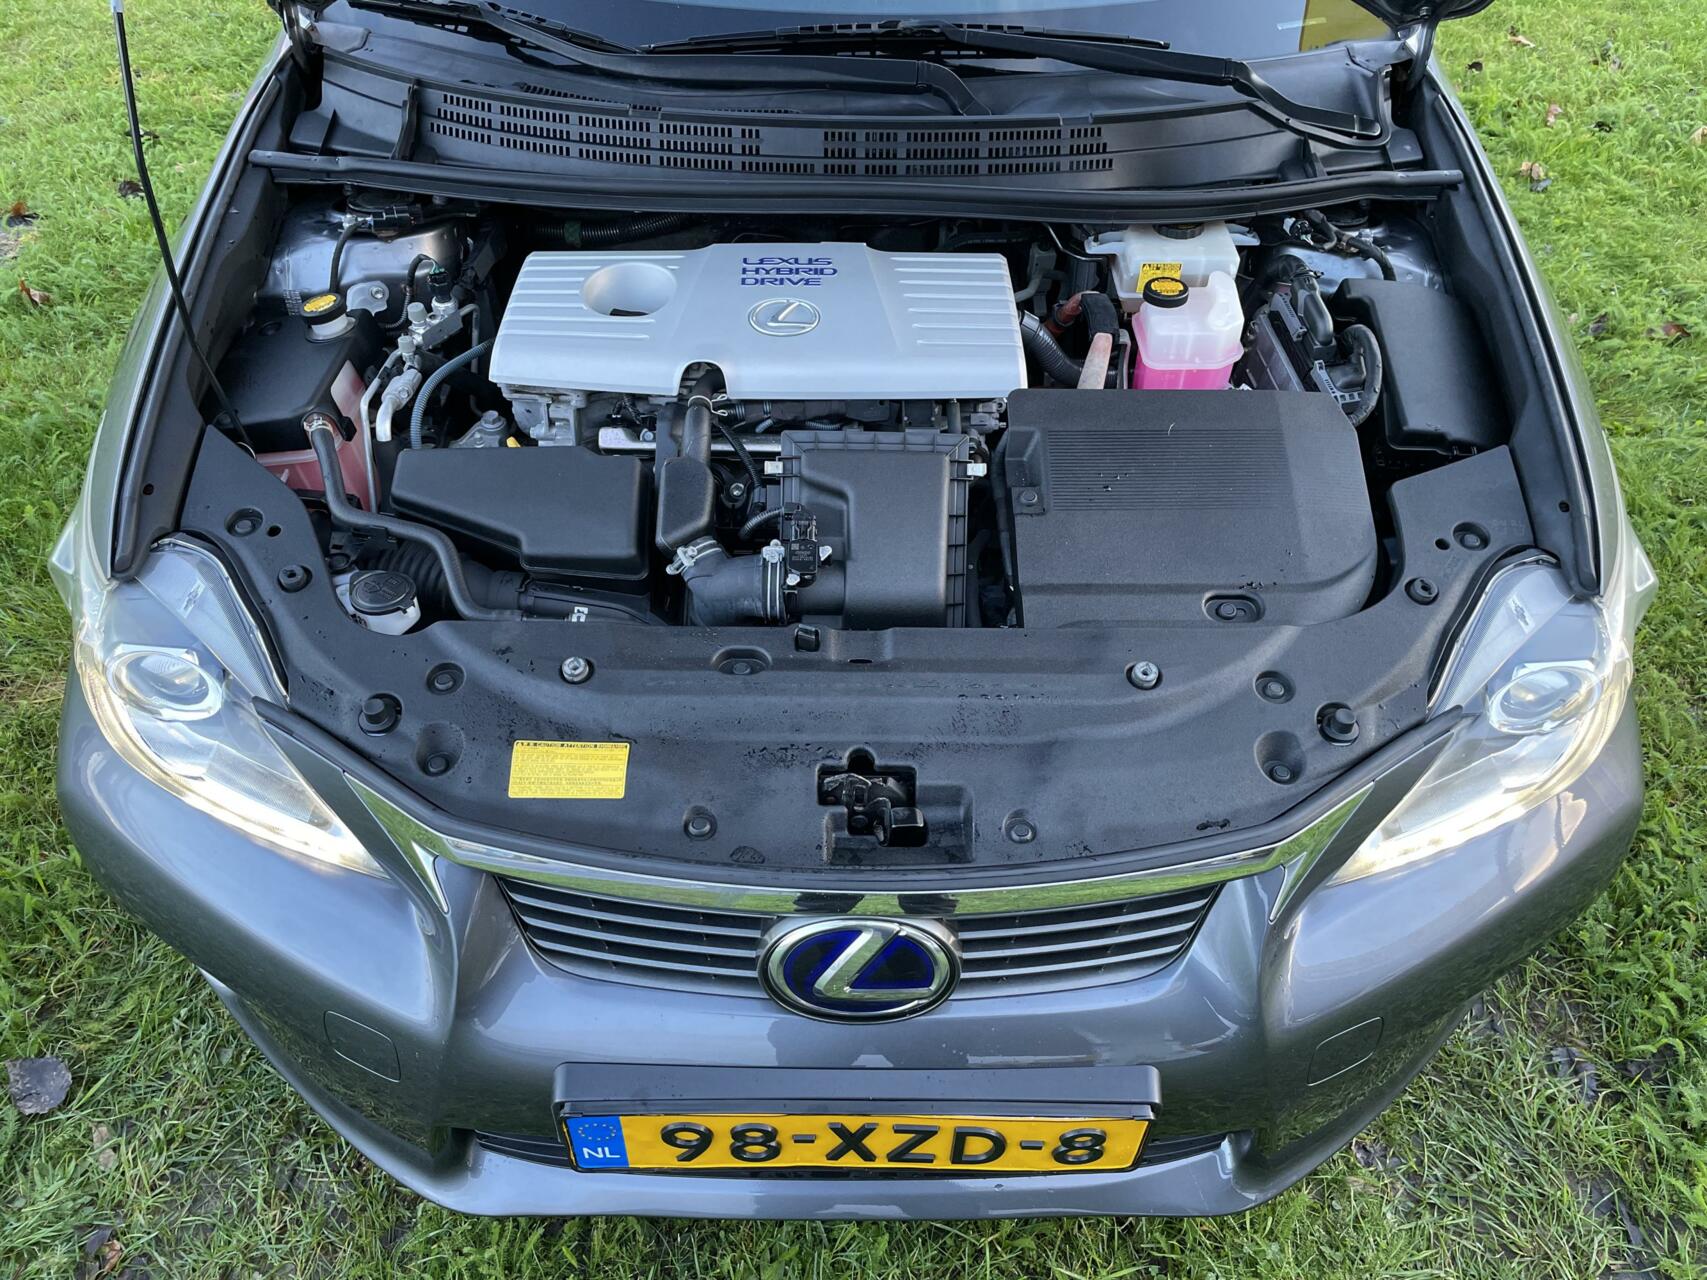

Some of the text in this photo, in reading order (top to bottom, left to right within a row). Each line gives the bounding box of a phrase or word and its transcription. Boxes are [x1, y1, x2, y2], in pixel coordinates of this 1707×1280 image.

[742, 257, 832, 265] LEXUS
[741, 267, 838, 276] HYBRID
[740, 277, 822, 286] DRIVE
[661, 1123, 1107, 1164] 98-XZD-8
[582, 1146, 621, 1159] NL
